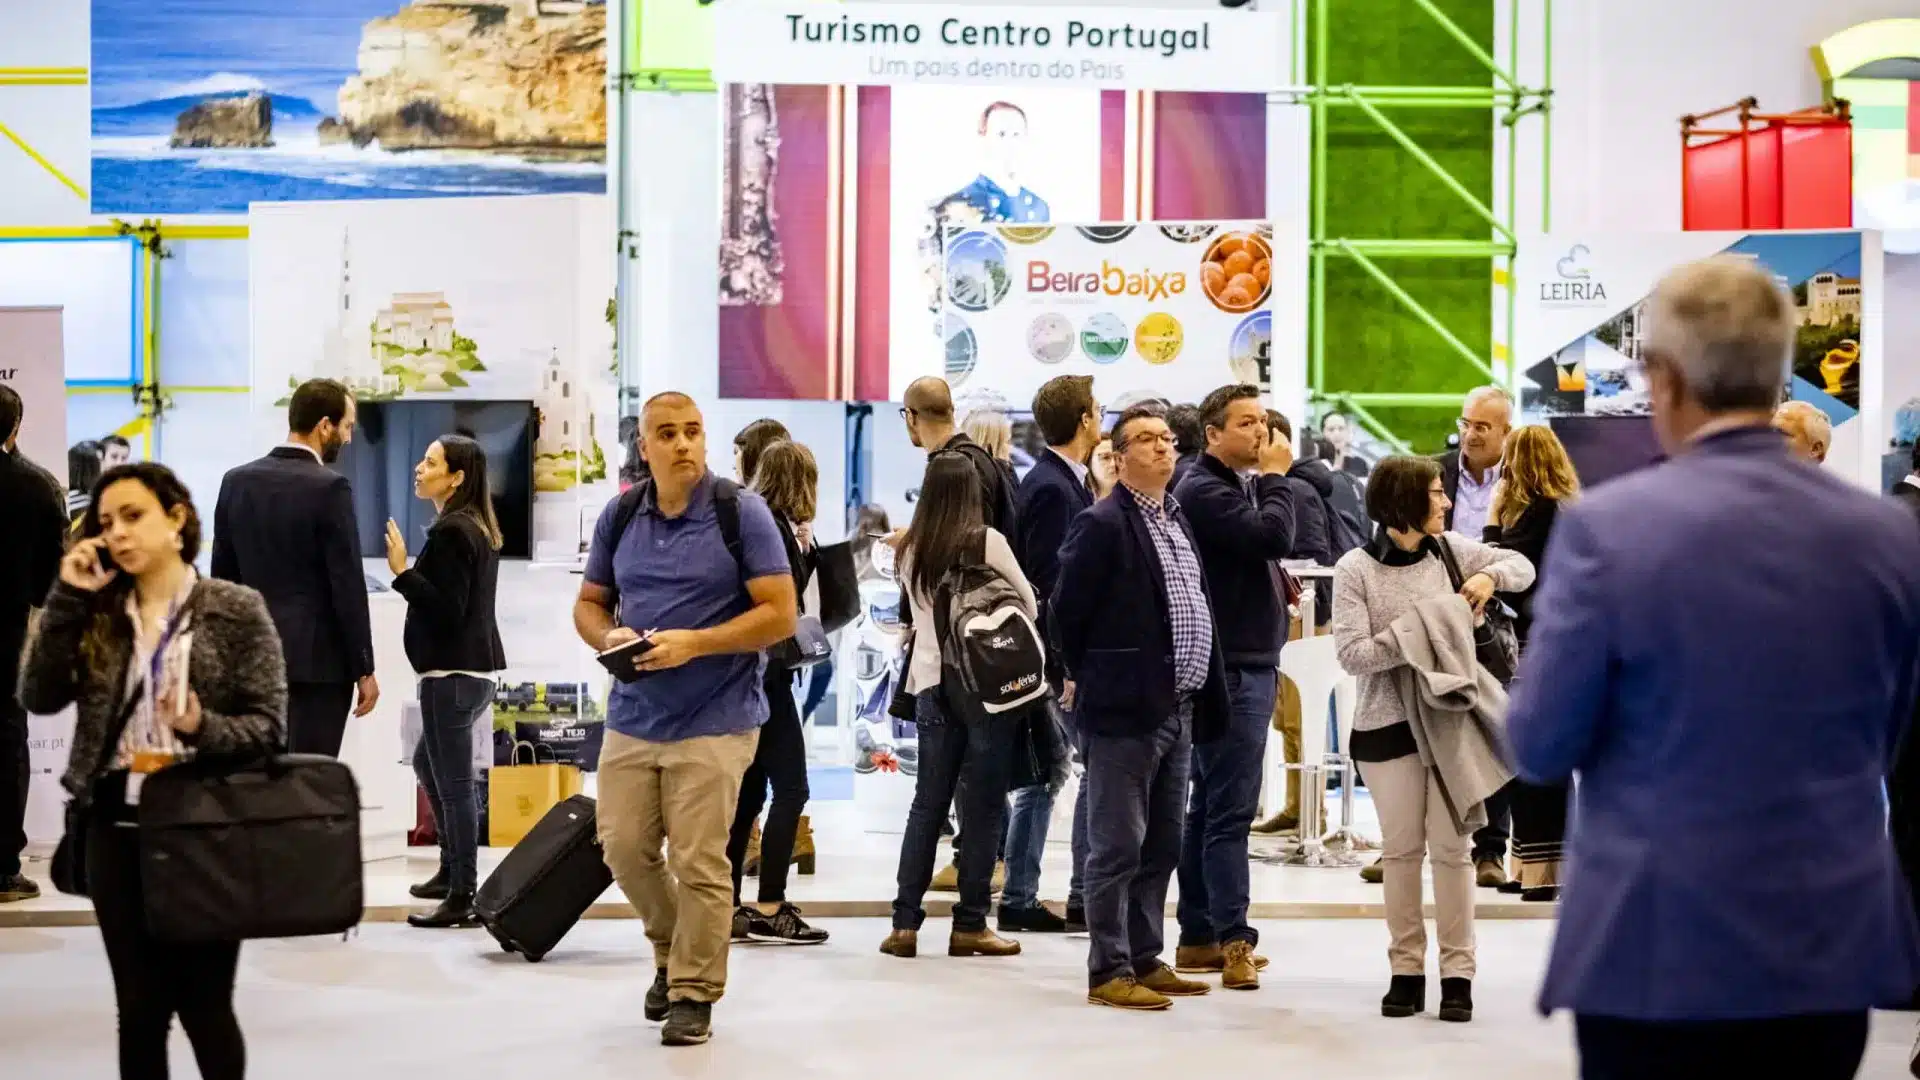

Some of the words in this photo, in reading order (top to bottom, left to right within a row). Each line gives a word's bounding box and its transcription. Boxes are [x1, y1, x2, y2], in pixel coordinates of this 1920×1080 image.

[786, 14, 920, 43] Turismo
[941, 18, 1051, 46] Centro
[1068, 21, 1209, 57] Portugal
[868, 56, 908, 75] Um
[966, 57, 1040, 78] dentro
[1047, 59, 1075, 79] do
[1540, 282, 1607, 301] LEIRIA
[566, 728, 586, 738] TEJO
